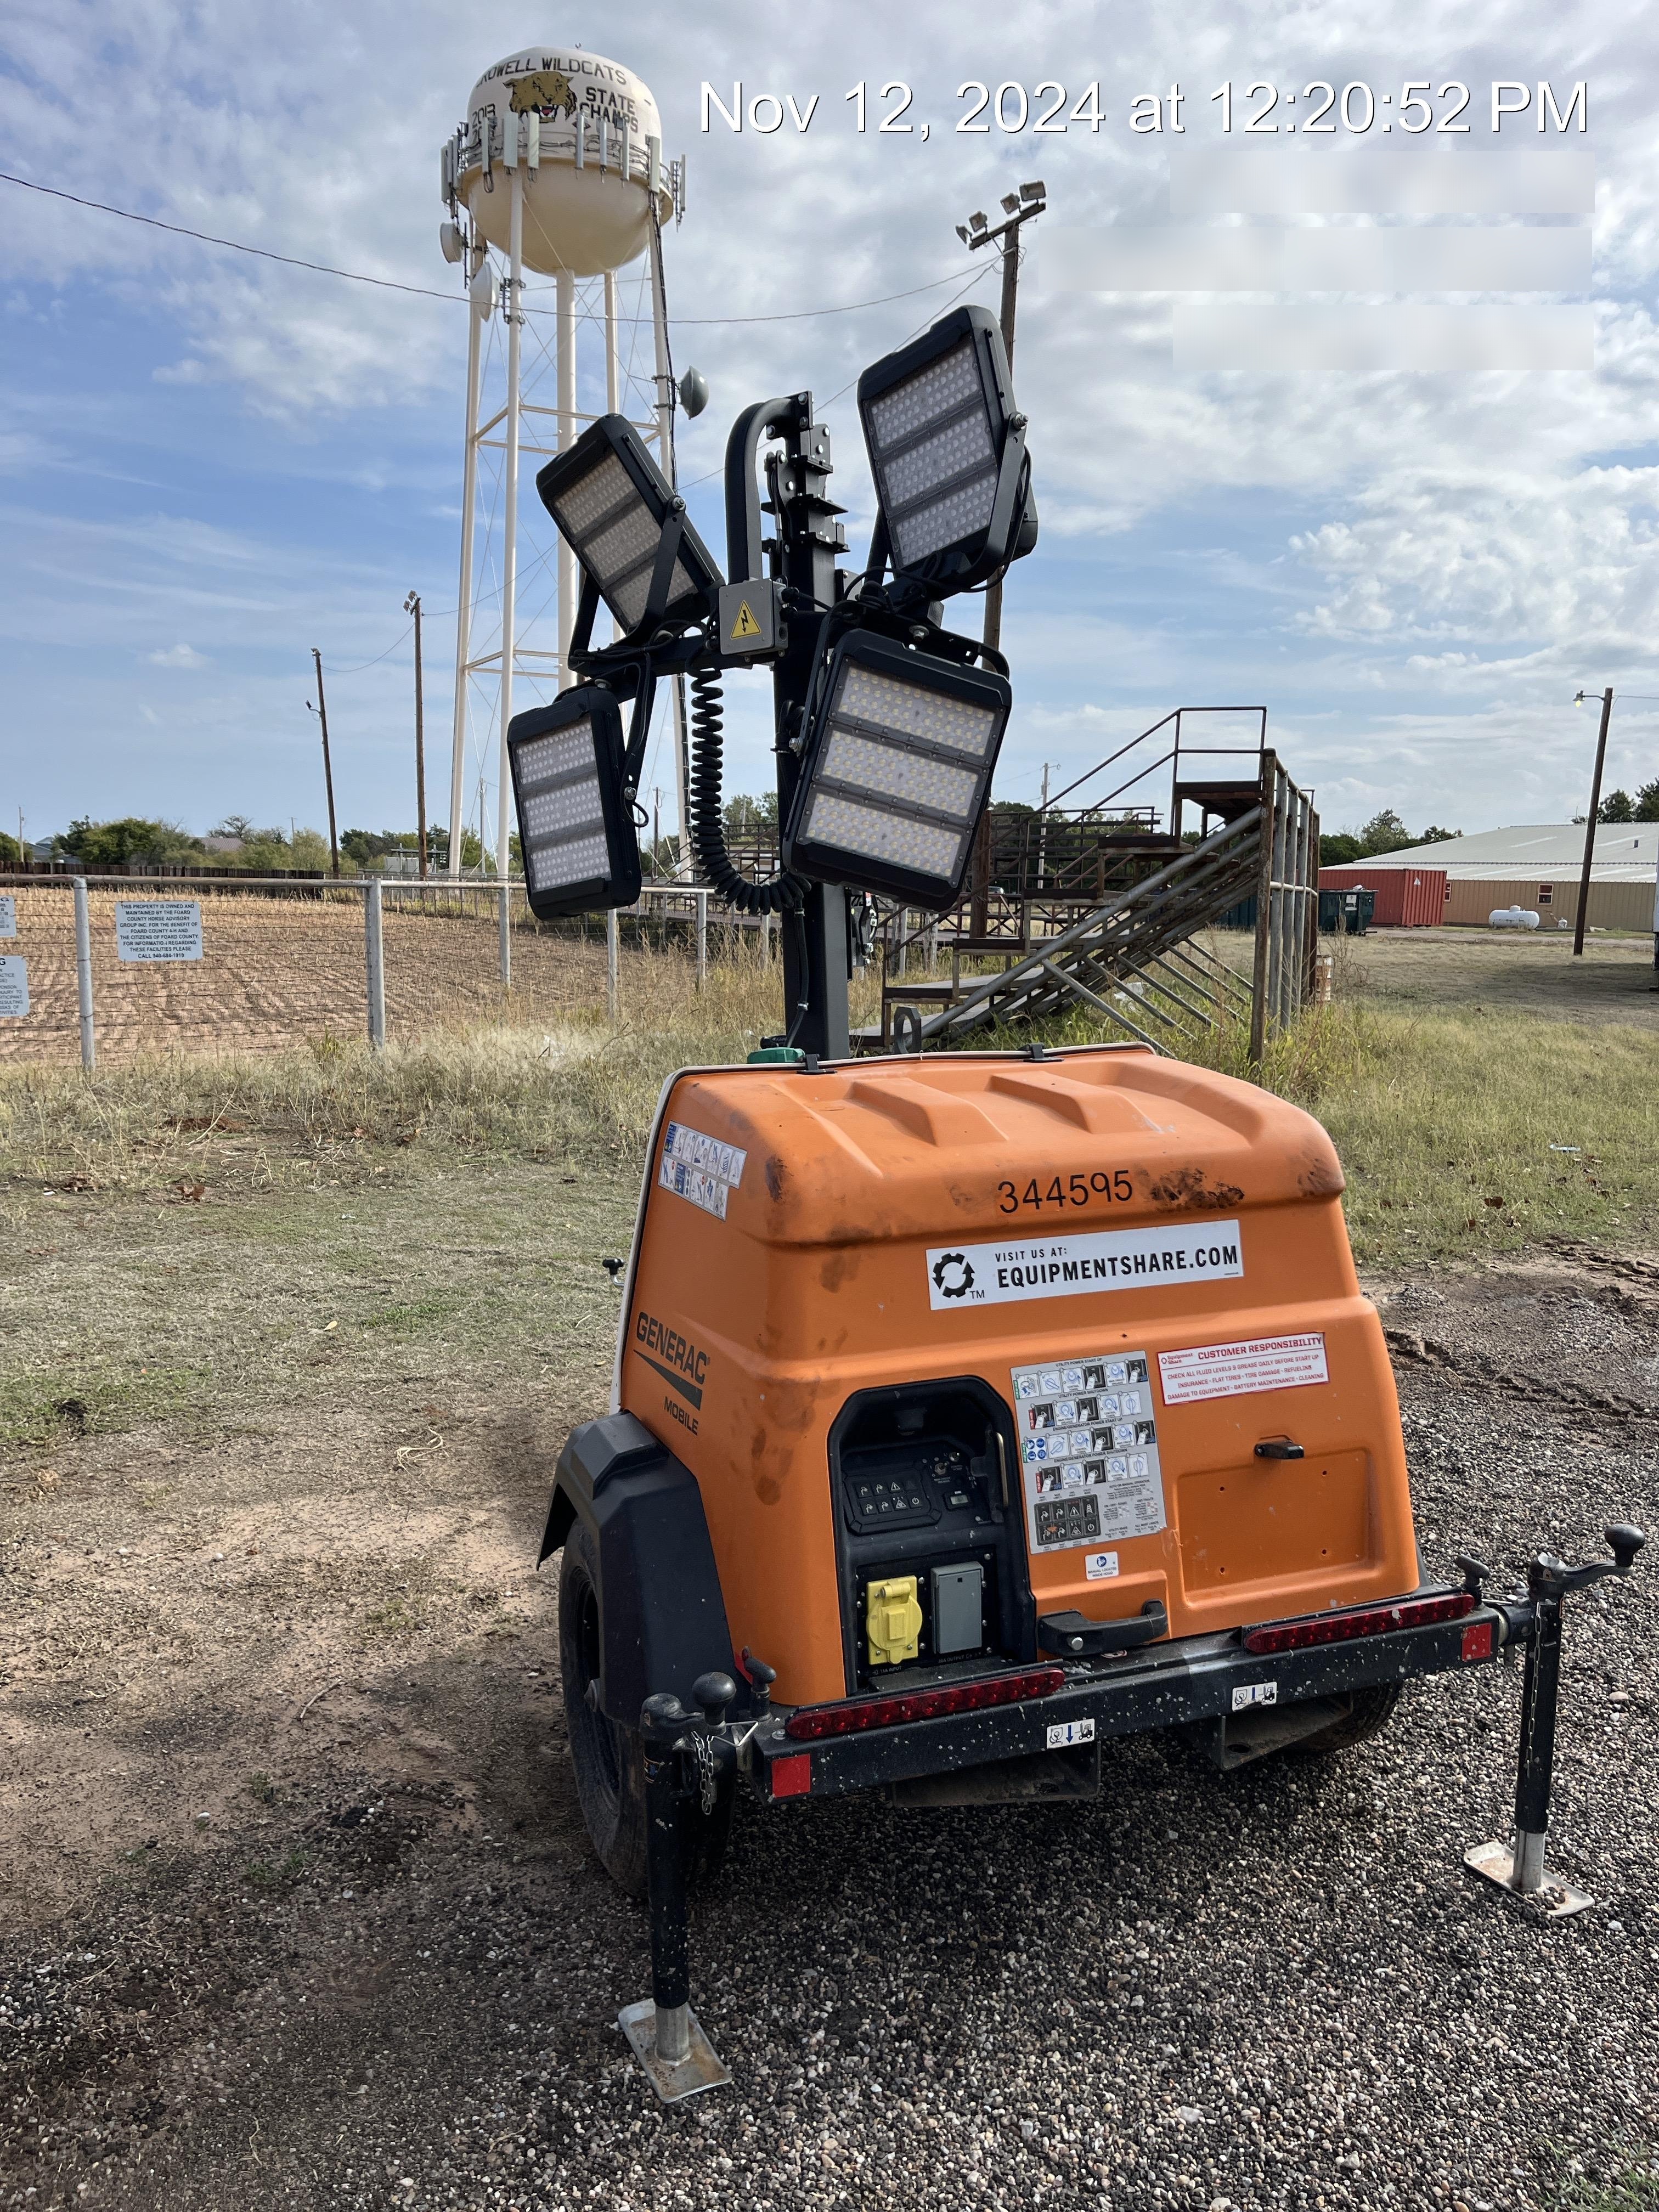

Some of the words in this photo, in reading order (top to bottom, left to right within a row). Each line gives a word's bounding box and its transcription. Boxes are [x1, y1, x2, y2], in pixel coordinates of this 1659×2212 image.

[542, 57, 627, 85] WILDCATS
[585, 86, 636, 116] STATE
[996, 1169, 1133, 1214] 344595
[995, 1250, 1025, 1262] VISIT
[1031, 1249, 1045, 1258] US
[1050, 1247, 1068, 1257] AT:
[997, 1244, 1238, 1288] EQUIPMENTSHARE.COM
[969, 1289, 985, 1300] TM
[636, 1311, 708, 1385] GENERAC
[1198, 1346, 1247, 1360] CUSTOMER
[1249, 1337, 1322, 1353] RESPONSIBILITY
[1167, 1391, 1190, 1400] DAMAGE
[1199, 1386, 1229, 1395] EQUIPMENT
[1257, 1376, 1295, 1386] MAINTENANCE
[1178, 1379, 1209, 1388] INSURANCE
[664, 1396, 699, 1437] MOBILE
